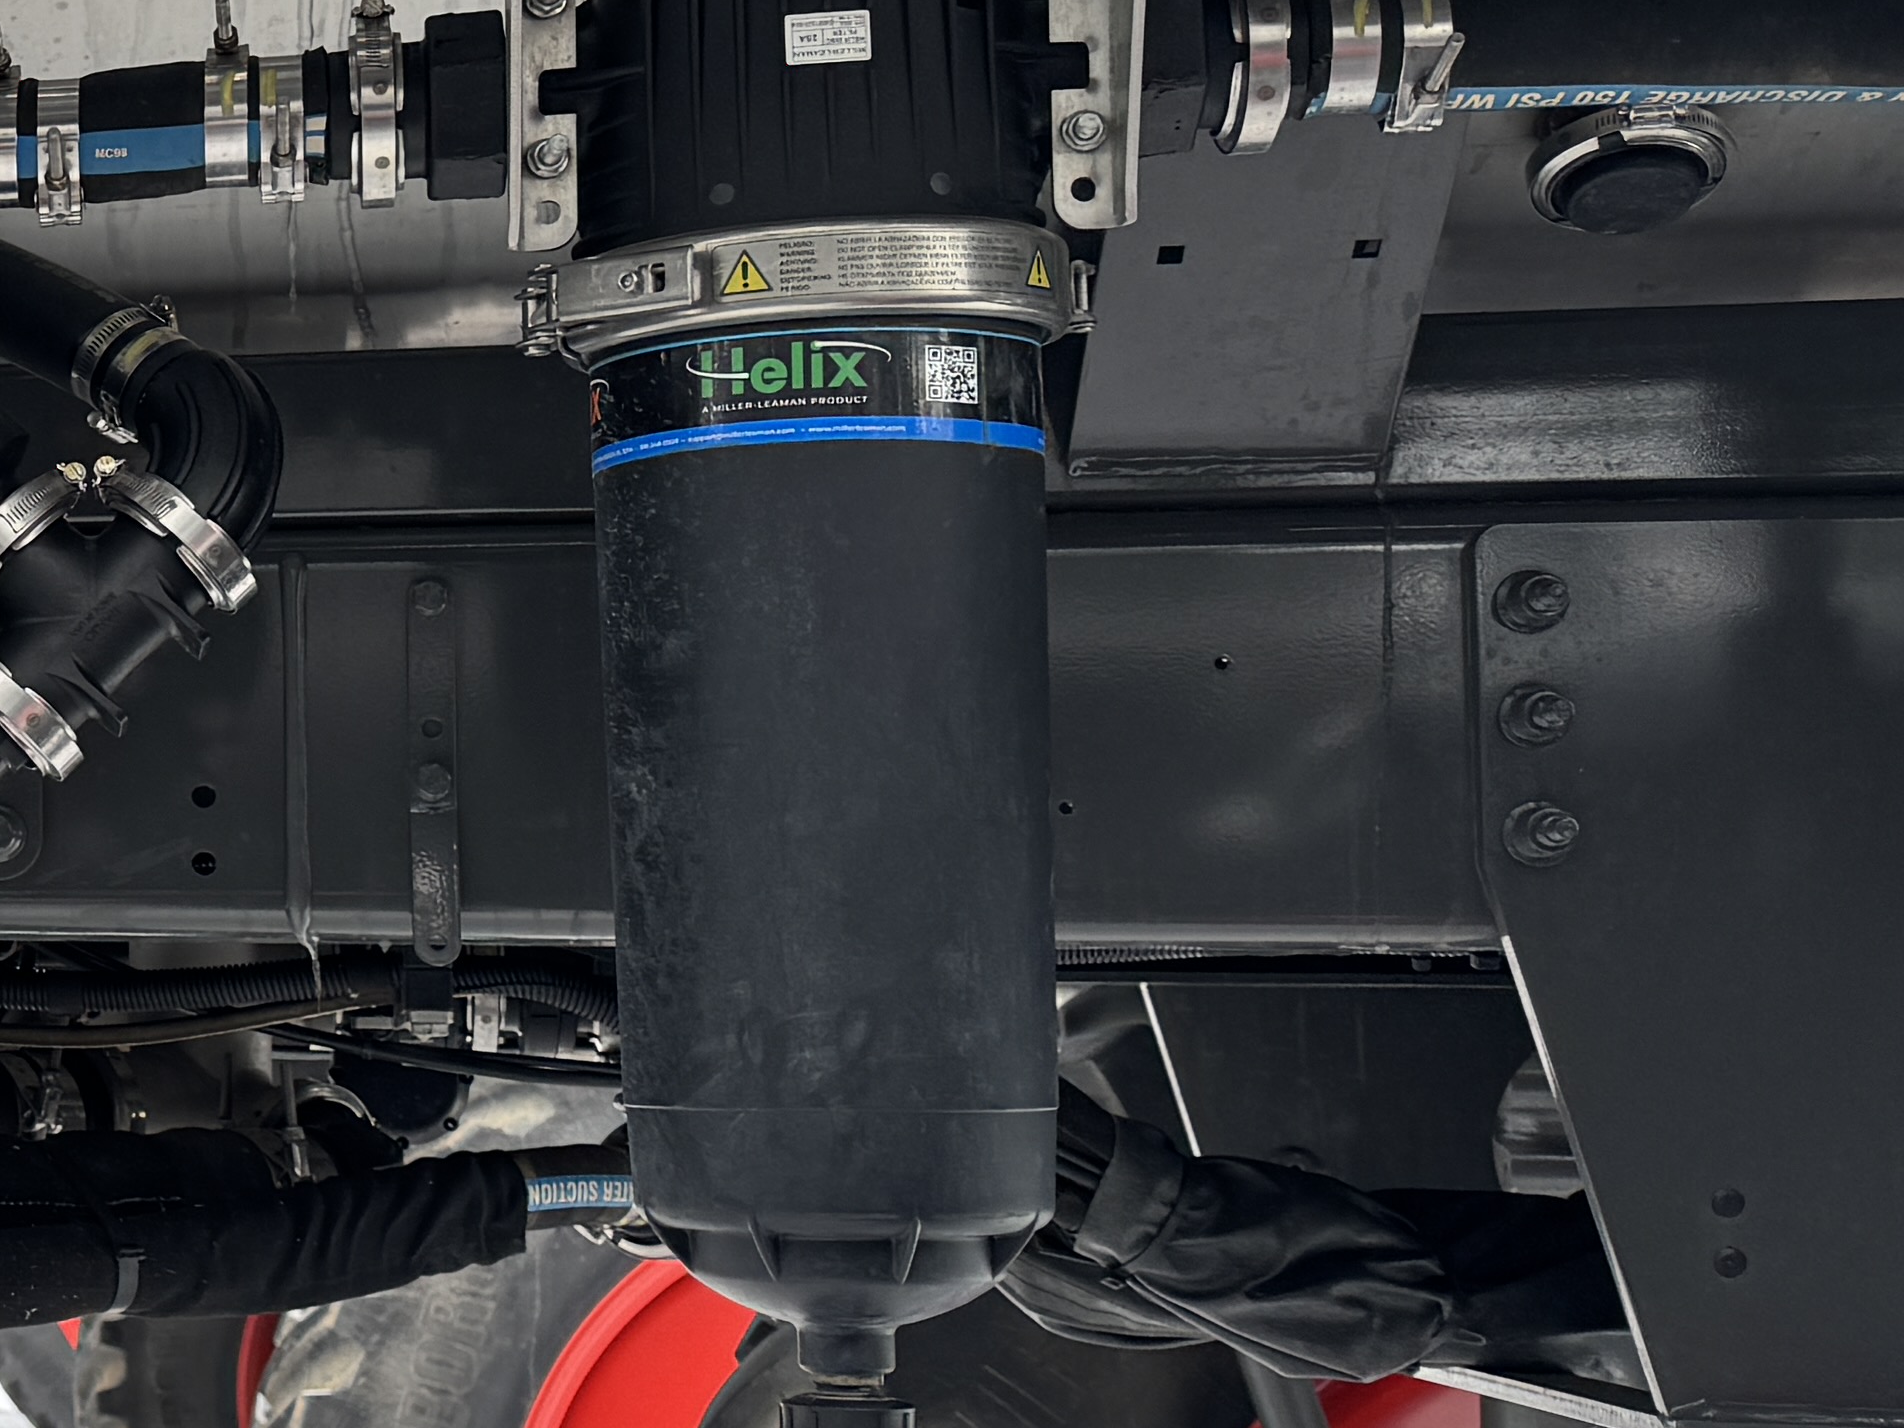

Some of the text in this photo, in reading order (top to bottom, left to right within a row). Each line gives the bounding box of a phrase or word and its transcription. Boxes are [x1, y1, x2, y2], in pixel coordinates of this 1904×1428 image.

[1505, 92, 1565, 107] PSI
[1576, 90, 1632, 106] 150
[1639, 89, 1845, 106] DISCHARGE
[700, 341, 869, 399] Helix
[701, 406, 709, 414] A
[810, 395, 869, 405] PRODUCT
[528, 1181, 598, 1206] SUCTION
